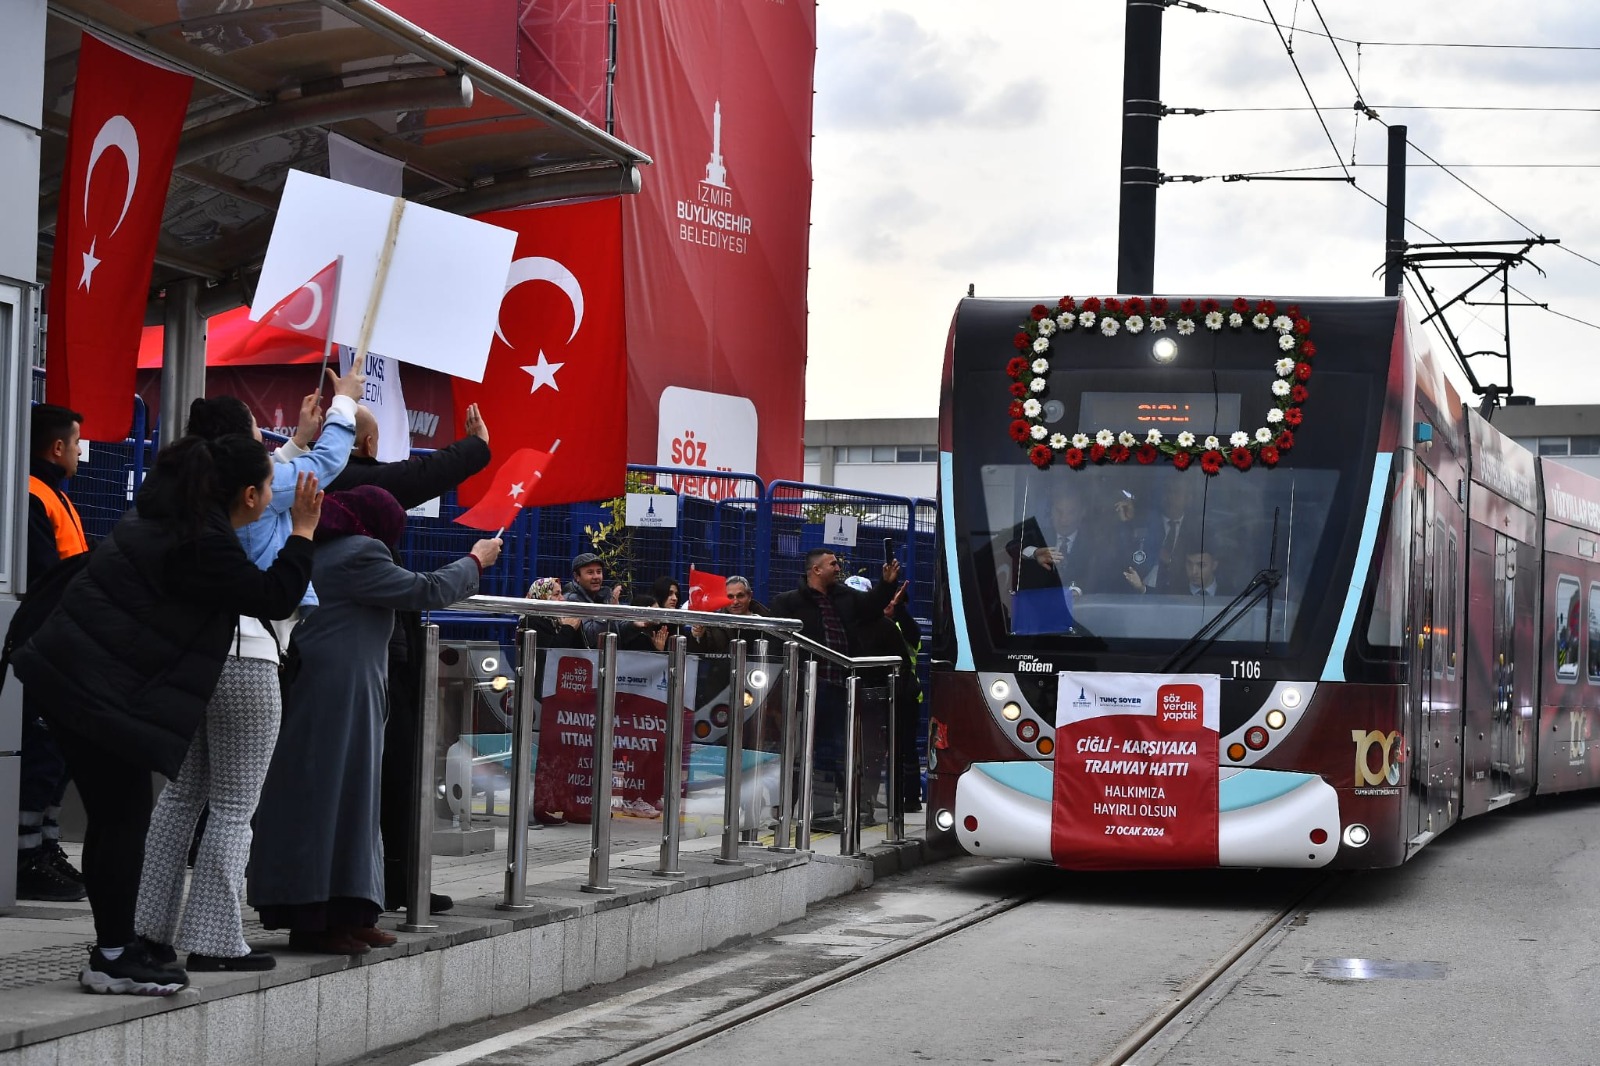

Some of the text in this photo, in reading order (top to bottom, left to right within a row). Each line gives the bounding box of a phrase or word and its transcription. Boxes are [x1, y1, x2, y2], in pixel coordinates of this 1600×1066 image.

[698, 183, 732, 208] İZMİR
[677, 200, 752, 235] BÜYÜKŞEHİR
[680, 224, 747, 254] BELEDİYESİ
[671, 430, 707, 467] söz
[1018, 658, 1053, 673] Rotem
[1231, 661, 1260, 679] T106
[1163, 693, 1181, 703] söz
[1163, 702, 1197, 711] verdik
[1163, 711, 1197, 721] yaptık
[1076, 736, 1112, 754] ÇİĞLİ
[1122, 740, 1197, 756] KARŞIYAKA
[1085, 759, 1189, 776] TRAMVAY HATTI
[1105, 785, 1165, 799] HALKIMIZA
[1093, 802, 1177, 818] HAYIRLI OLSUN
[1105, 825, 1165, 837] 27 OCAK 2024
